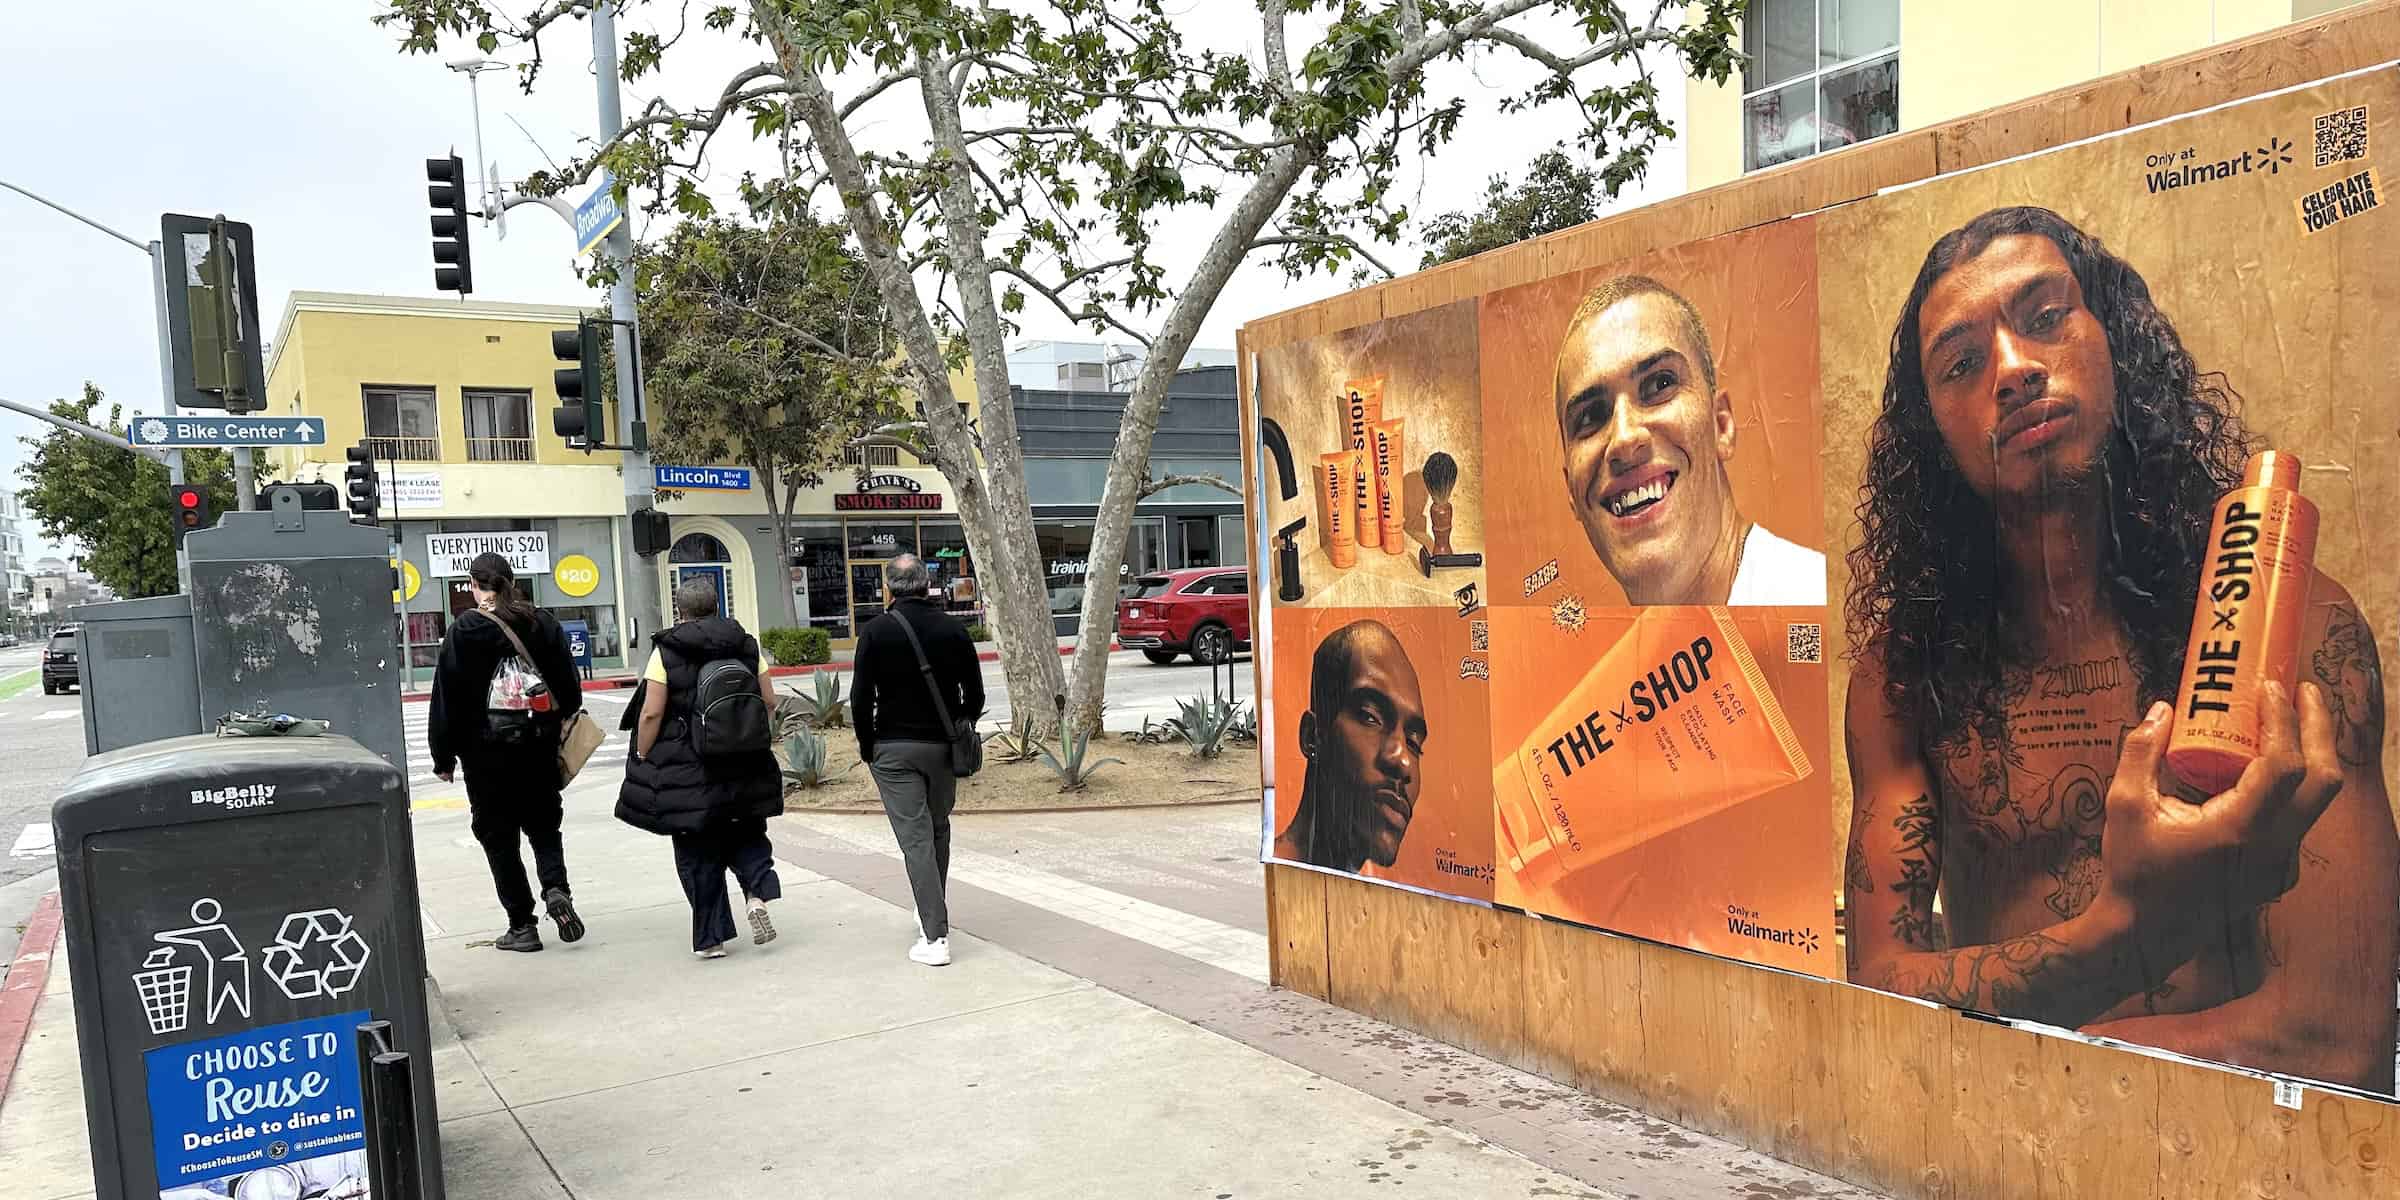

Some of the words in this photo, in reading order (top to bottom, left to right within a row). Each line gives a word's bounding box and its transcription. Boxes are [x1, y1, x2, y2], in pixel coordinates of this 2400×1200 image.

[2146, 151, 2175, 168] Only
[2180, 147, 2195, 160] at
[2146, 151, 2252, 194] Walmart
[2302, 171, 2372, 215] CELEBRATE
[2303, 208, 2339, 232] YOUR
[2341, 189, 2378, 218] HAIR
[577, 194, 615, 239] Broadway
[176, 423, 218, 439] Bike
[224, 423, 286, 439] Center
[1351, 390, 1364, 450] SHOP
[1378, 431, 1389, 476] SHOP
[661, 468, 719, 484] Lincoln
[723, 471, 741, 479] Blvd
[1328, 464, 1338, 499] SHOP
[1356, 471, 1367, 510] THE
[837, 494, 896, 509] SMOKE
[900, 494, 941, 509] SHOP
[1382, 489, 1390, 519] THE
[871, 534, 895, 544] 1456
[1332, 509, 1340, 534] THE
[431, 535, 513, 555] EVERYTHING
[508, 556, 528, 569] ALE
[2210, 502, 2261, 604] SHOP
[2188, 639, 2240, 720] THE
[1547, 711, 1614, 777] THE
[1630, 635, 1713, 723] SHOP
[1712, 690, 1735, 725] WASH
[1722, 683, 1747, 718] FACE
[191, 784, 276, 804] BigBelly
[226, 797, 266, 809] SOLAR
[1436, 857, 1480, 878] Walmart
[1727, 904, 1748, 919] Only
[1751, 911, 1759, 919] at
[1727, 917, 1794, 945] Walmart
[186, 1037, 296, 1080] CHOOSE
[304, 1031, 338, 1059] TO
[206, 1070, 329, 1122] Reuse
[183, 1125, 256, 1151] Decide
[261, 1119, 282, 1134] to
[287, 1111, 331, 1130] dine
[335, 1105, 356, 1120] in
[180, 1149, 264, 1175] #ChooseToReuseSM
[294, 1131, 362, 1152] @sustainablesm
